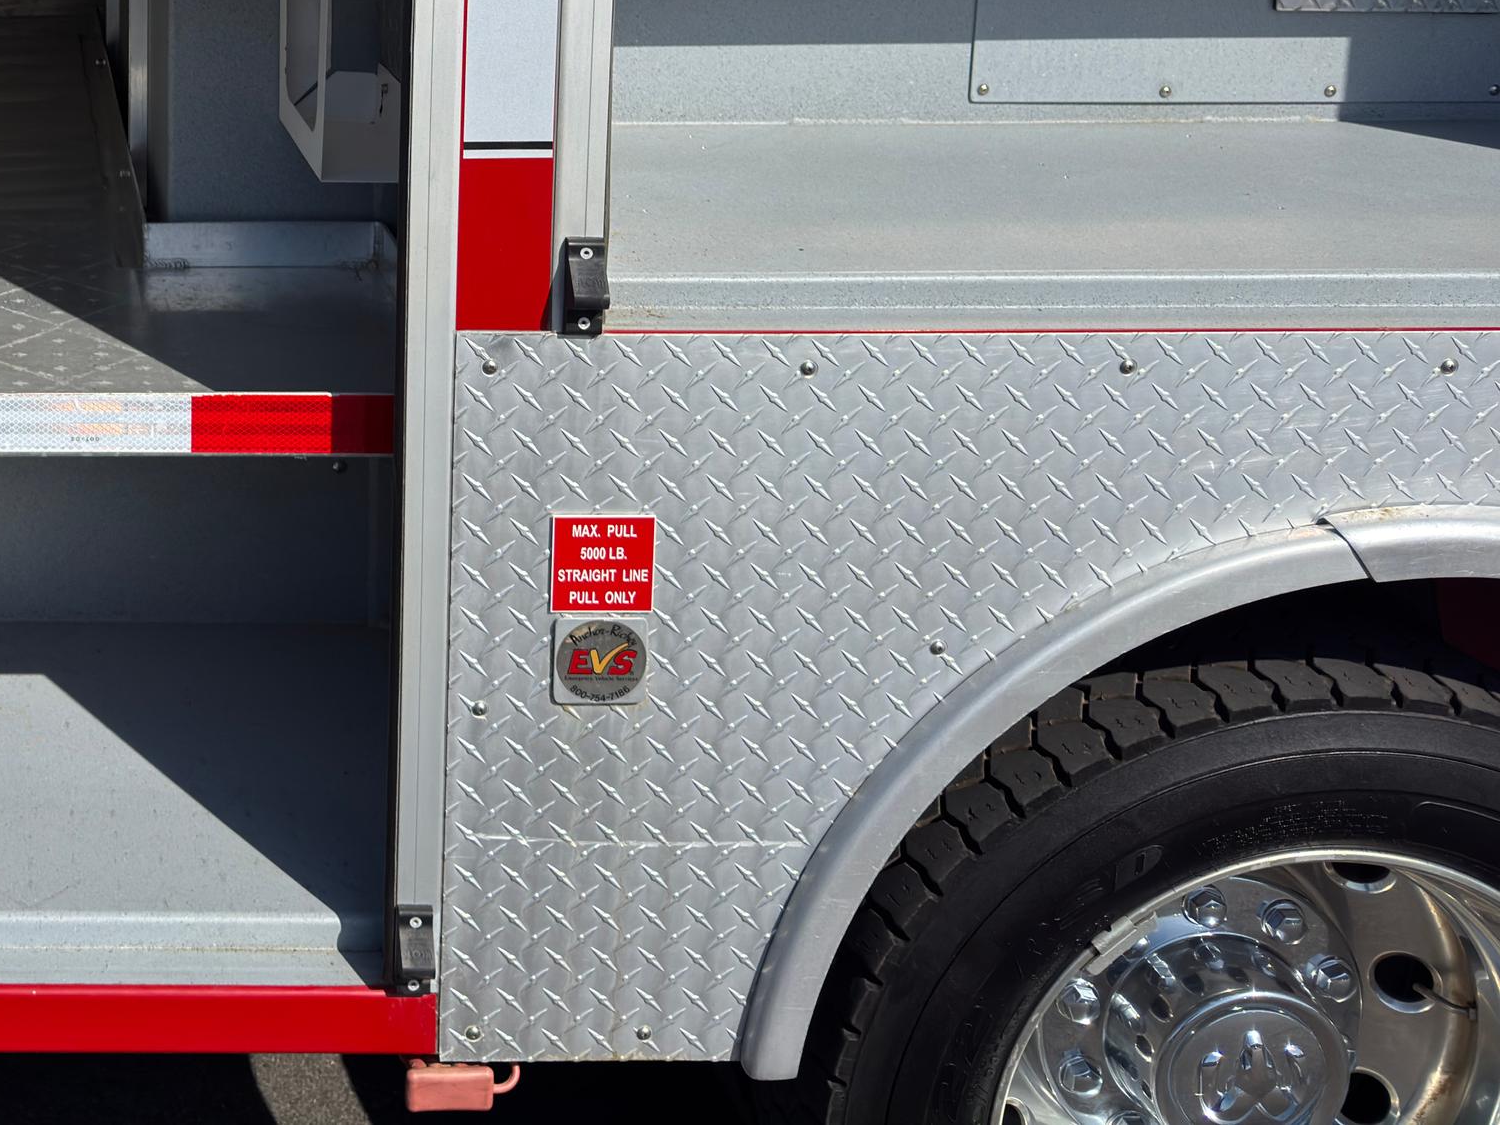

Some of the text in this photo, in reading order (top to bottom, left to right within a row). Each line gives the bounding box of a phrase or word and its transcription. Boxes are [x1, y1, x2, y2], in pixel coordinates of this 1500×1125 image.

[572, 524, 638, 538] MAX. PULL
[580, 547, 628, 560] 5000 LB.
[557, 569, 649, 582] STRAIGHT LINE
[569, 591, 636, 604] PULL ONLY
[567, 642, 638, 676] EVS
